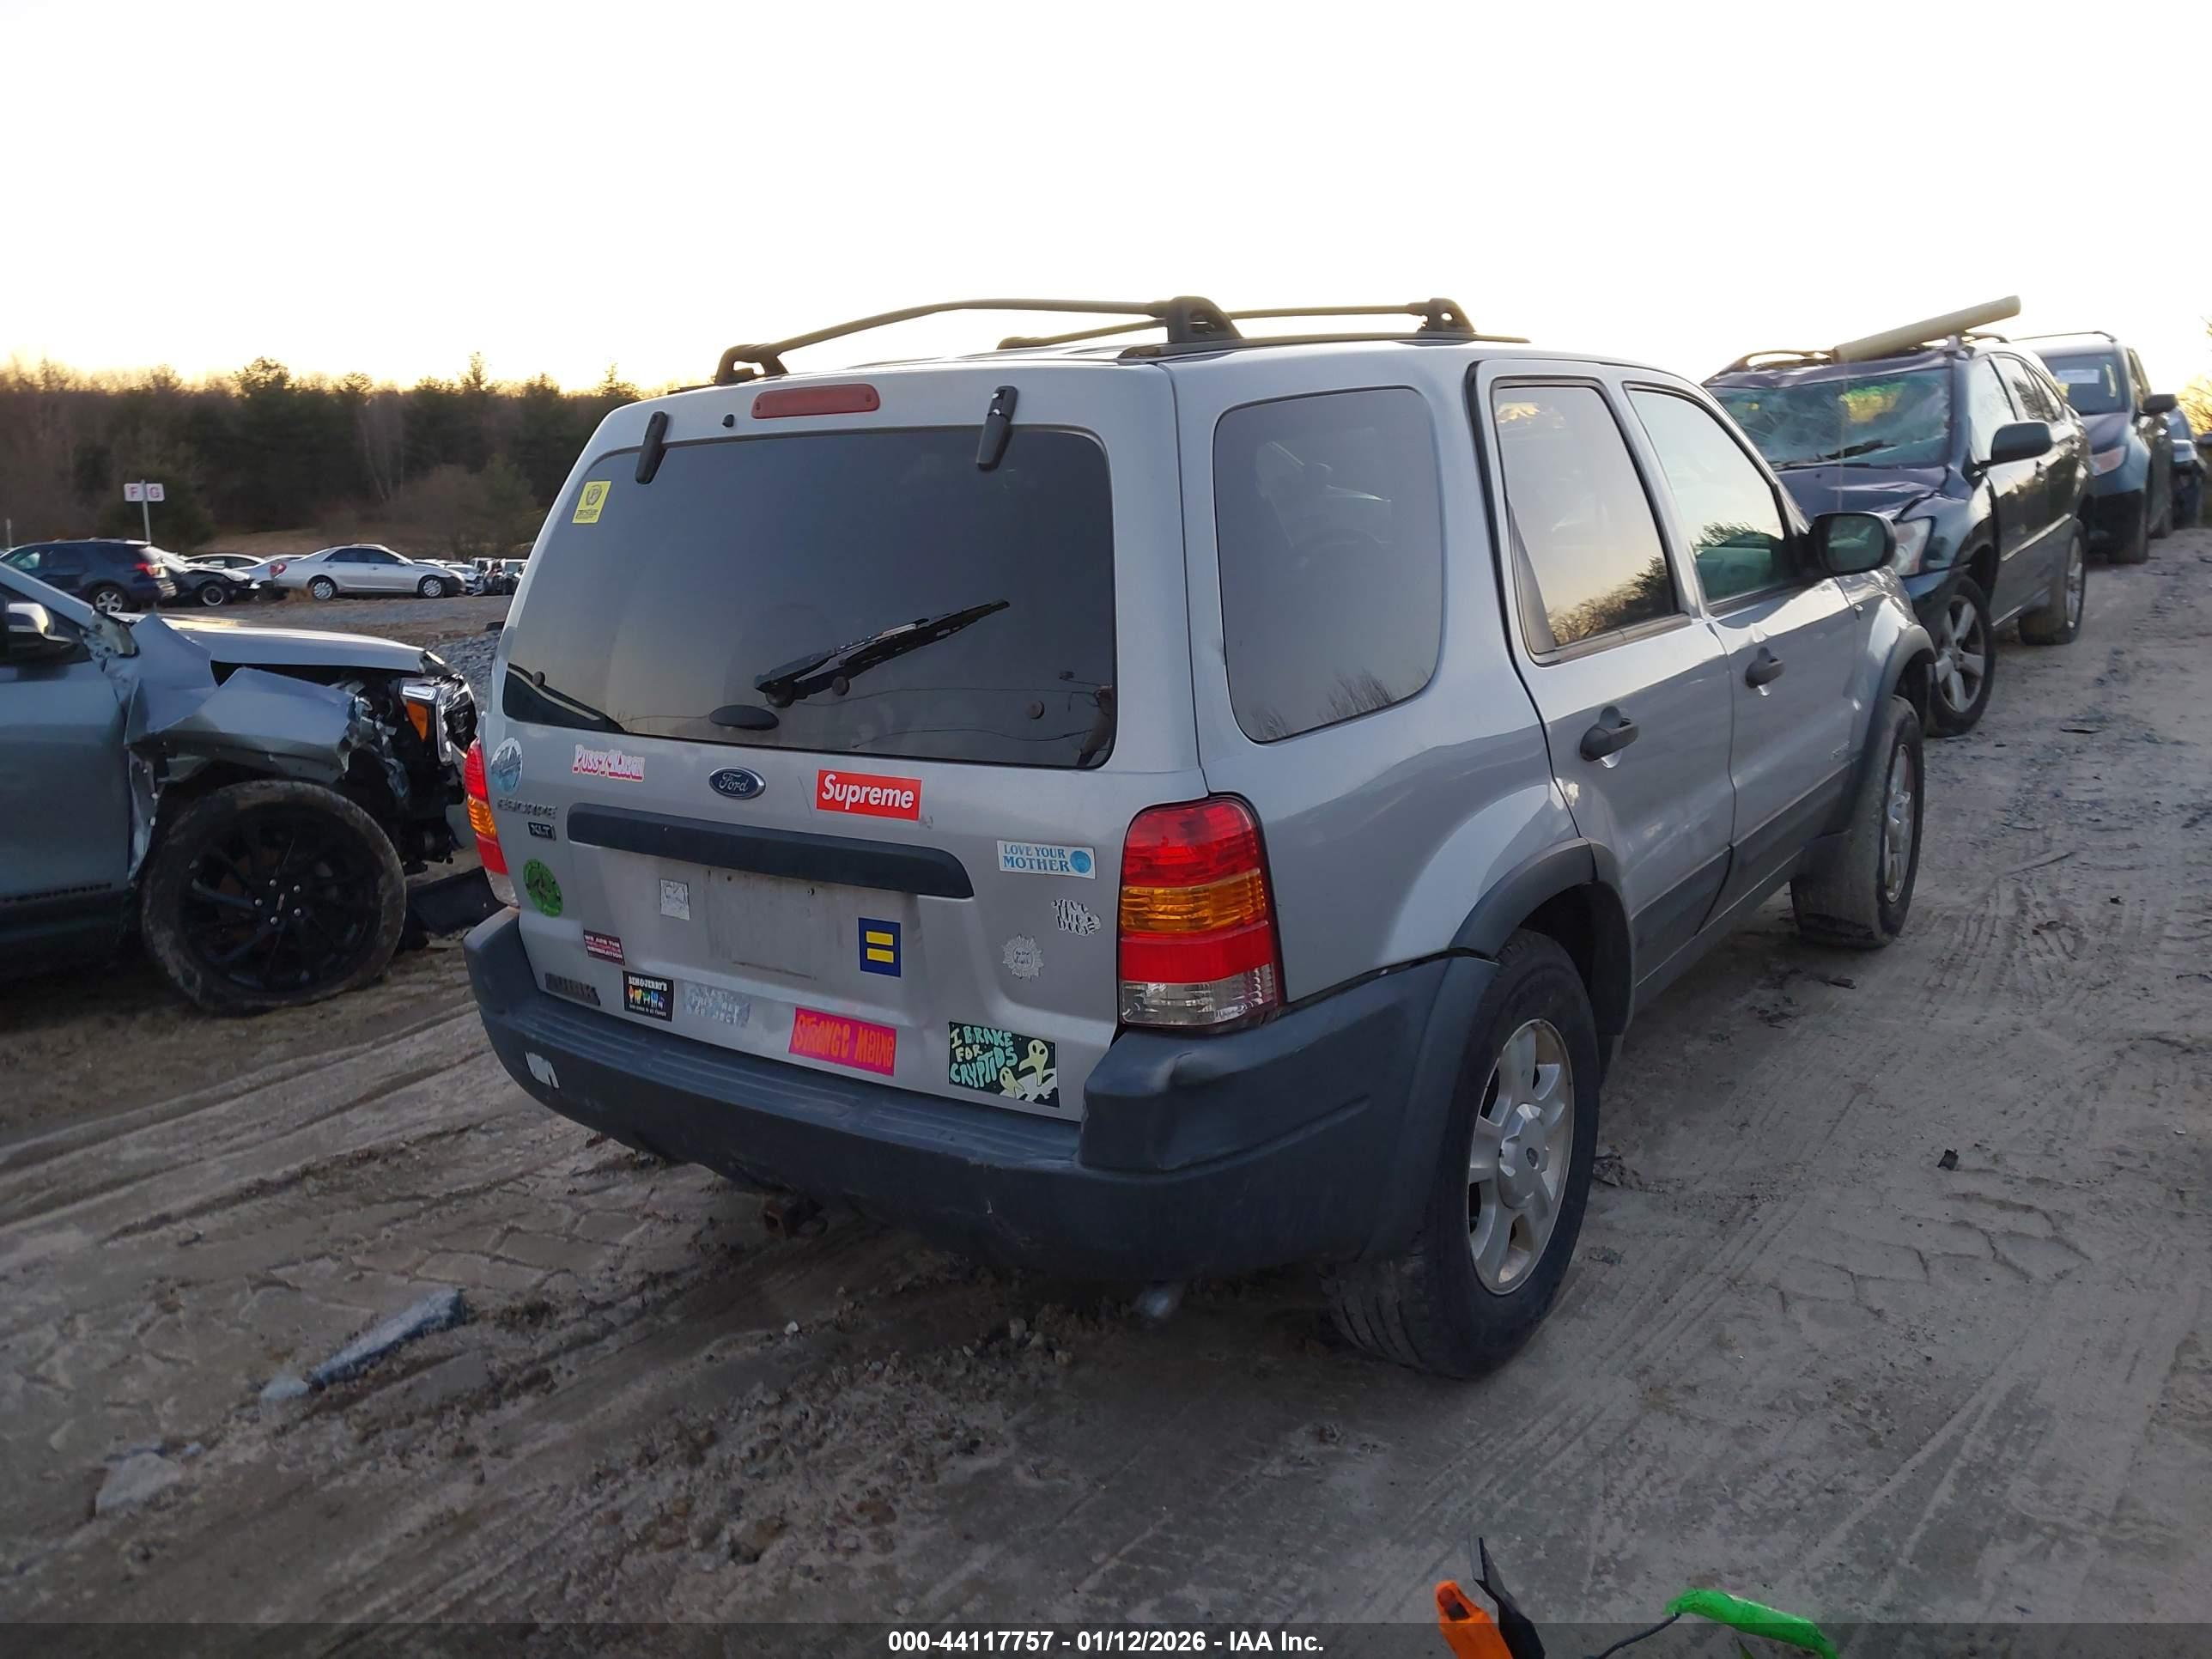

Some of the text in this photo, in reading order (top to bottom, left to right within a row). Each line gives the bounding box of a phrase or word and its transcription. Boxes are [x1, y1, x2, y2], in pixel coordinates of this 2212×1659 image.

[130, 486, 138, 498] F
[149, 486, 160, 498] G
[719, 773, 749, 792] Ford
[822, 774, 915, 811] Supreme
[1004, 844, 1066, 859] LOVE YOUR
[1003, 855, 1070, 872] MOTHER
[951, 1025, 1014, 1048] I BRAKE
[955, 1044, 983, 1062] FOR
[950, 1046, 1018, 1088] CRYPTIDS
